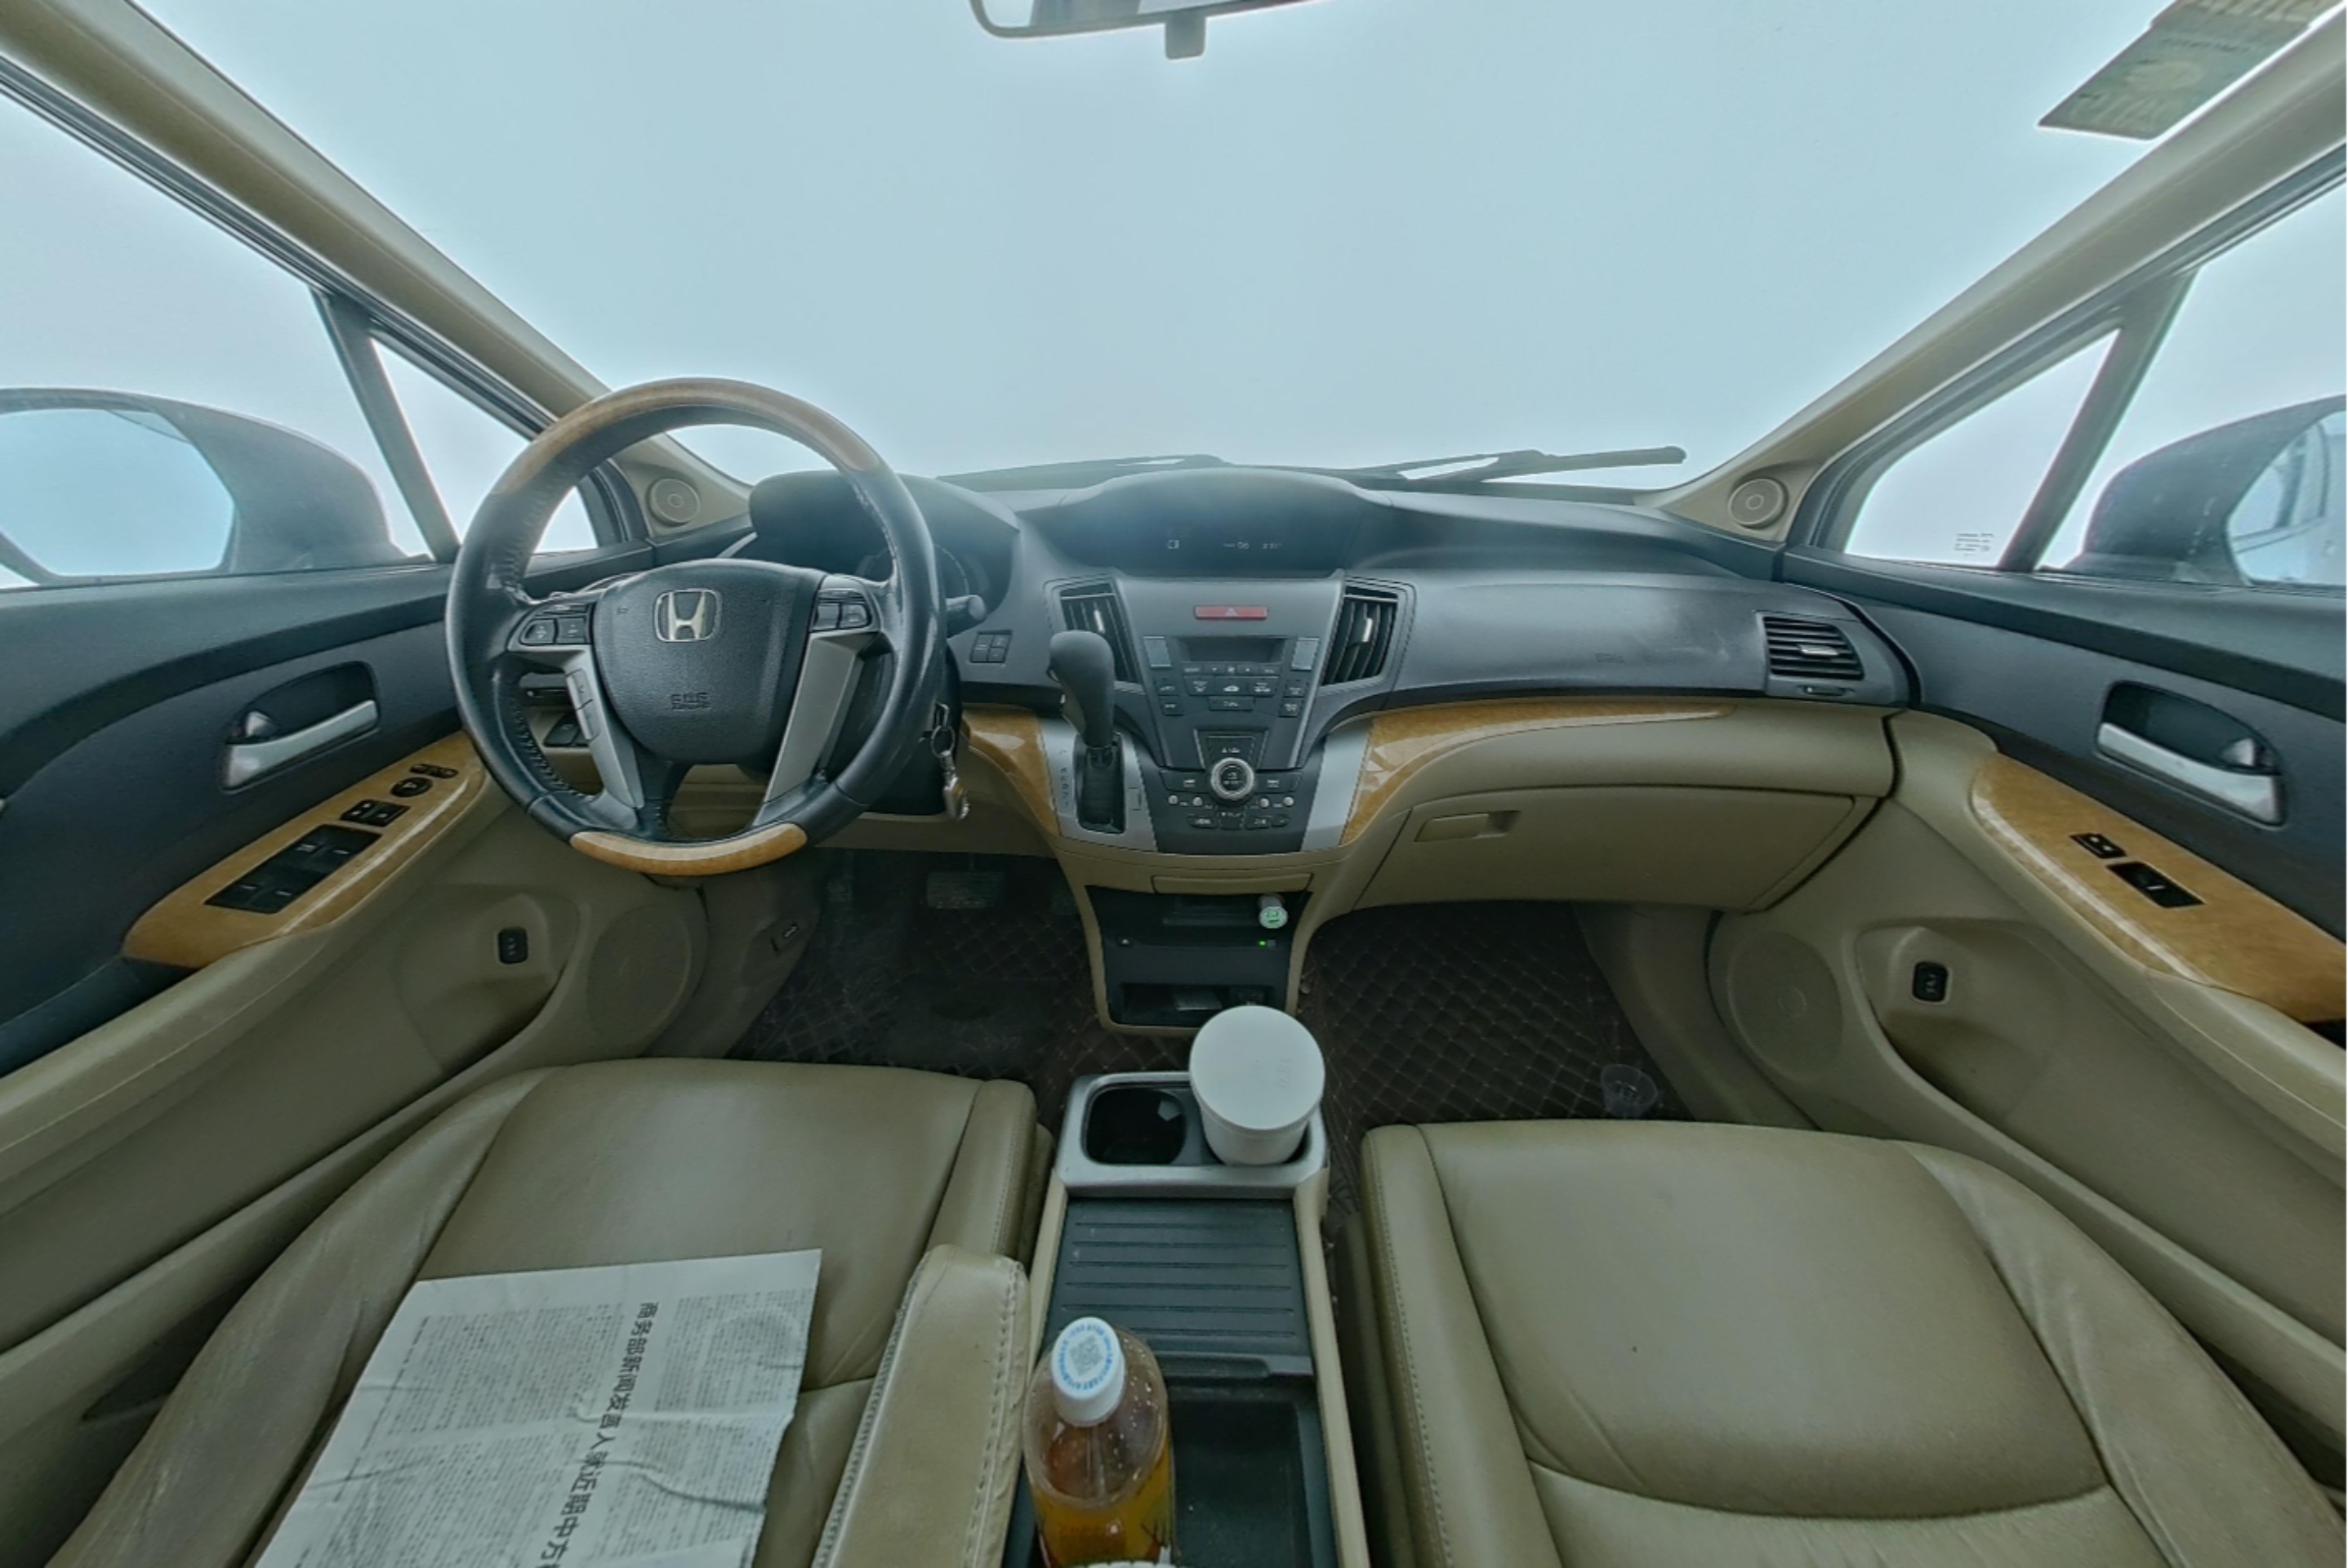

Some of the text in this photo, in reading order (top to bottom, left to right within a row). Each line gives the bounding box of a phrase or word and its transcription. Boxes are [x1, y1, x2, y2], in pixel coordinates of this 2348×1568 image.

[535, 1302, 659, 1568] 商务部新闻发言人就近期中方
